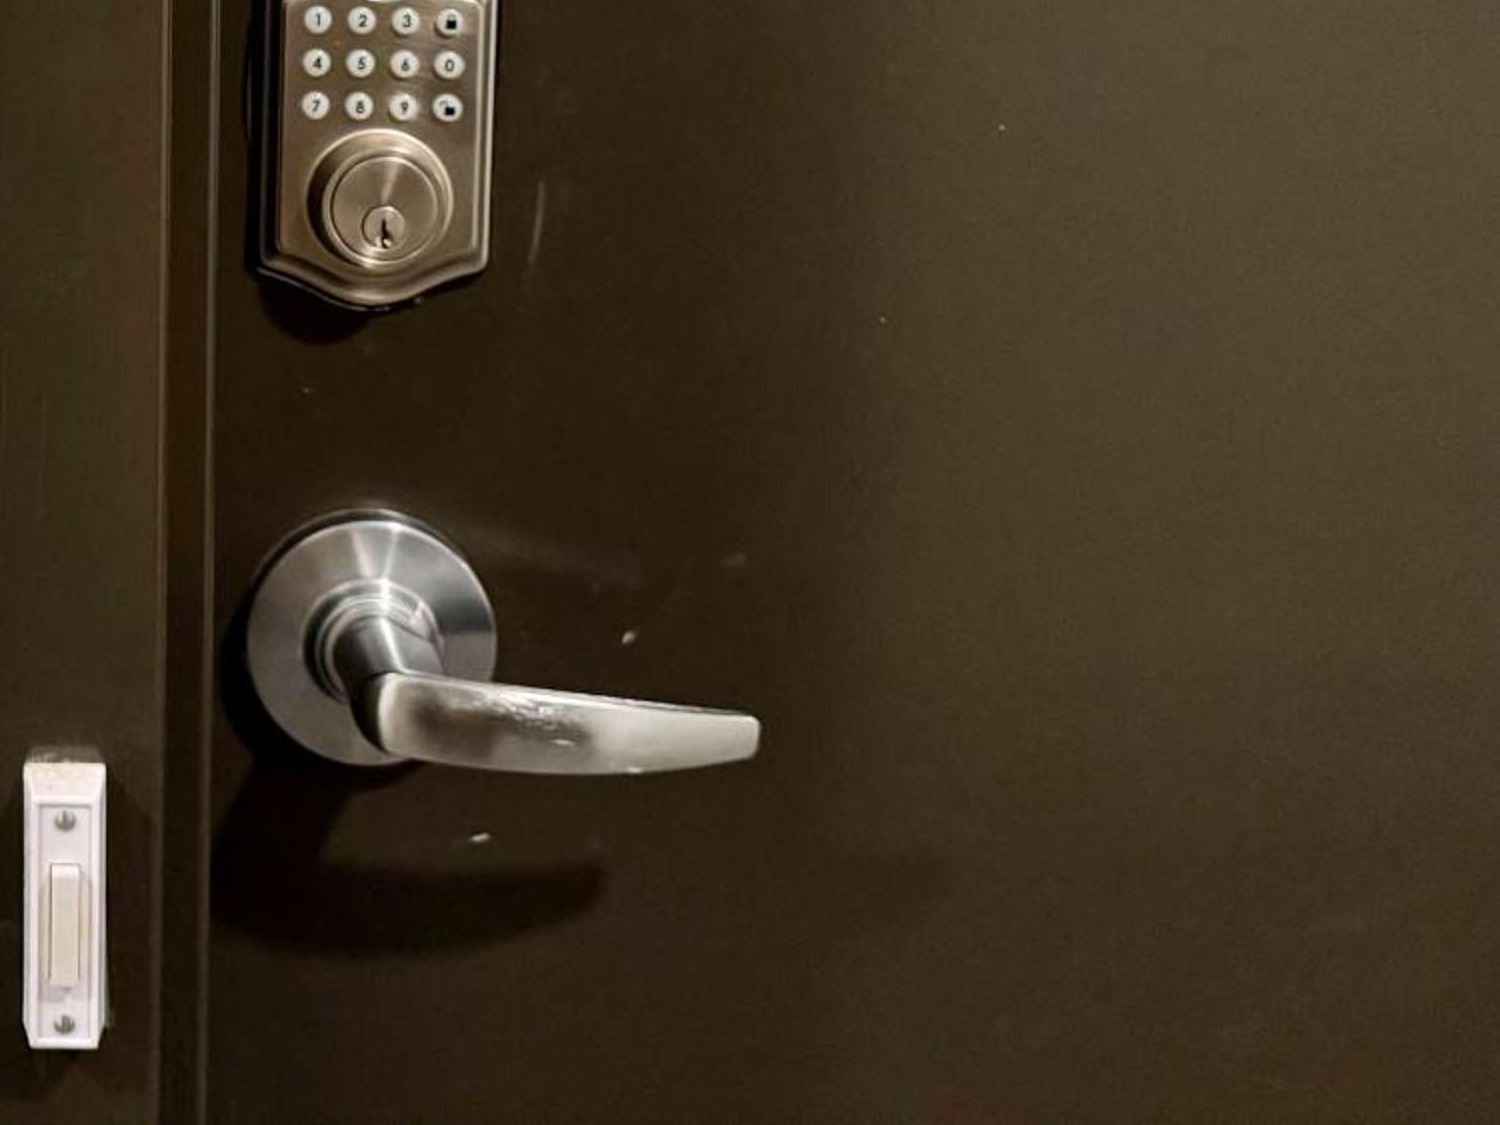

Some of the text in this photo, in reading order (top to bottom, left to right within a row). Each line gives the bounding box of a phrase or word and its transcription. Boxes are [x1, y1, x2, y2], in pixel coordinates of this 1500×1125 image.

[358, 14, 367, 27] 2
[402, 14, 411, 28] 3
[313, 56, 455, 72] 4 5 6 0
[312, 100, 409, 114] 7 8 9
